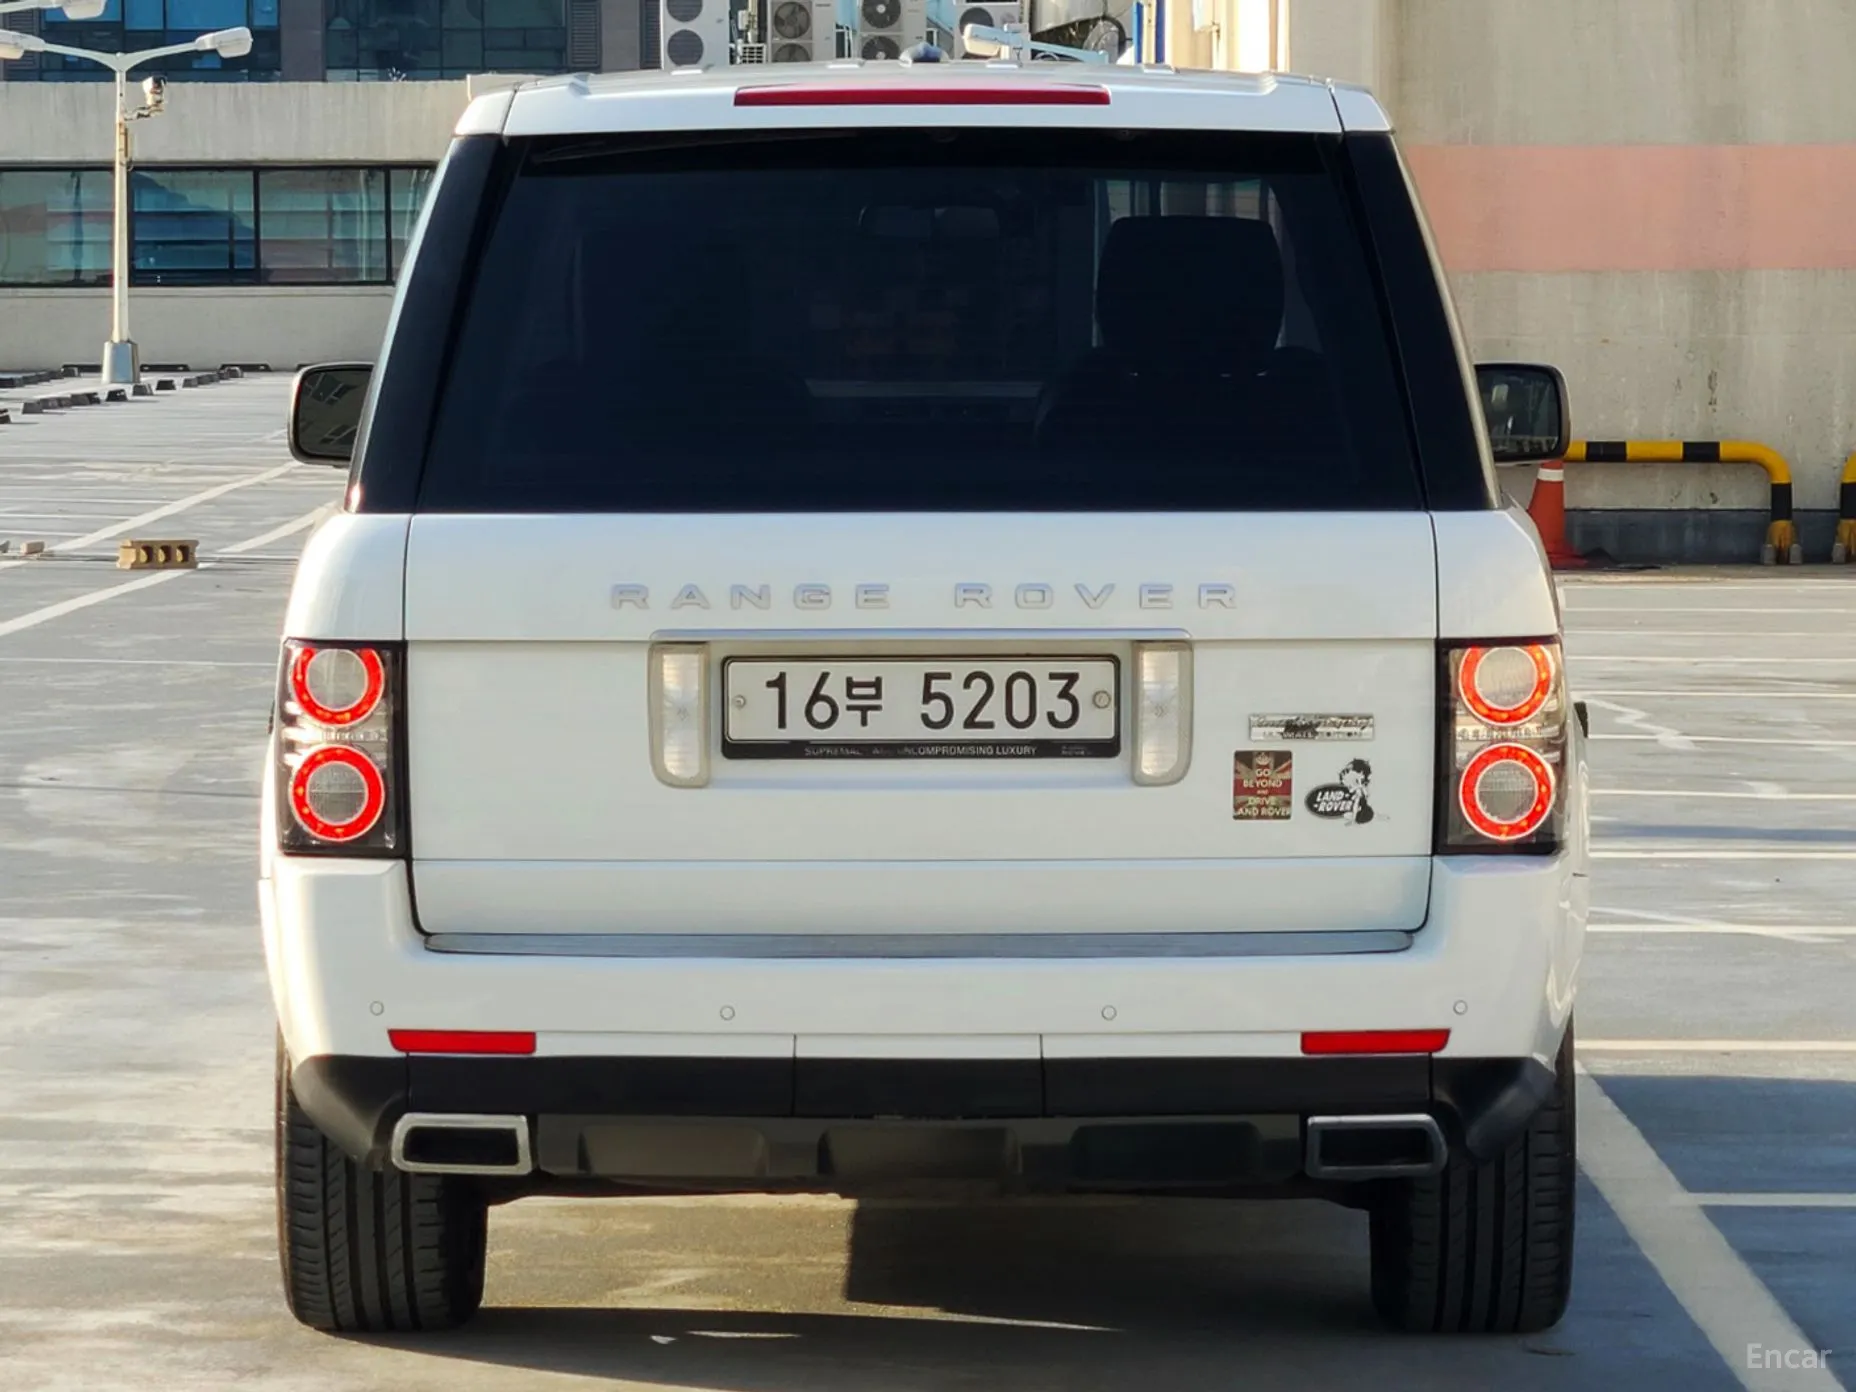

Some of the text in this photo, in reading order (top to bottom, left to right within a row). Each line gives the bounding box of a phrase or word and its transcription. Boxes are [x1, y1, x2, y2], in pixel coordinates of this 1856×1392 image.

[610, 582, 1238, 610] RANGE ROVER
[765, 671, 1081, 730] 16부 5203
[995, 745, 1037, 757] LUXURY
[1256, 768, 1271, 778] GO
[1243, 779, 1283, 788] BEYOND
[1248, 796, 1277, 805] DRIVE
